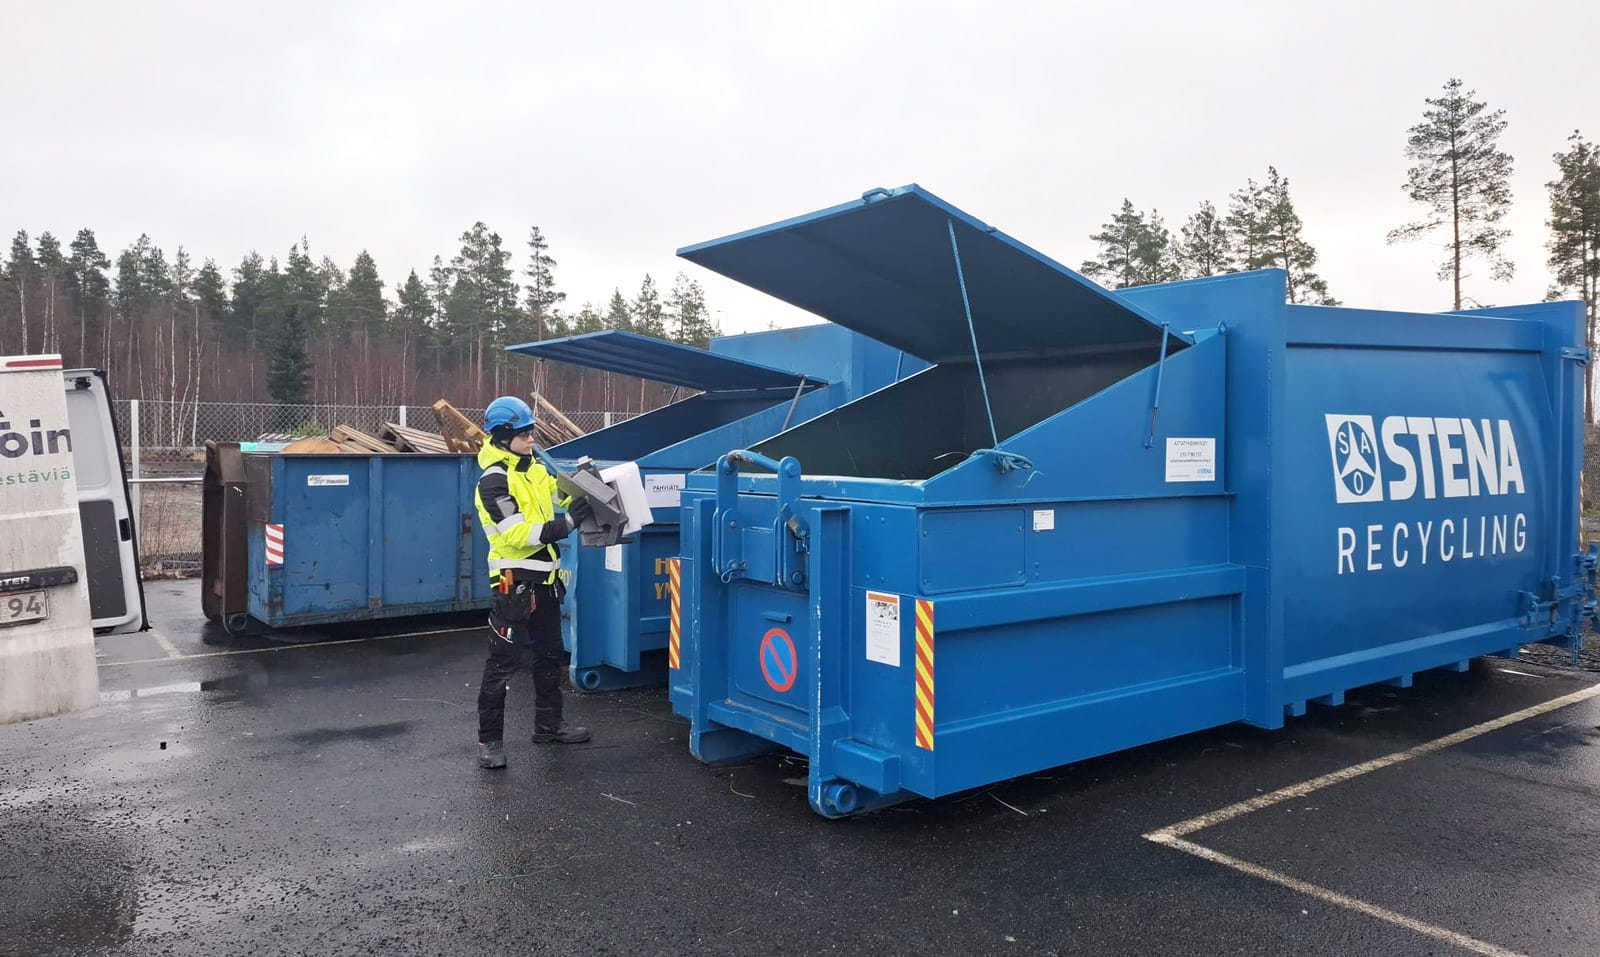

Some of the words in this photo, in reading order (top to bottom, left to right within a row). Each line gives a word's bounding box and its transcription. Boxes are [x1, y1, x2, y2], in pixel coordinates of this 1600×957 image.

[1381, 415, 1526, 501] STENA
[1337, 512, 1527, 575] RECYCLING
[0, 576, 30, 587] TER
